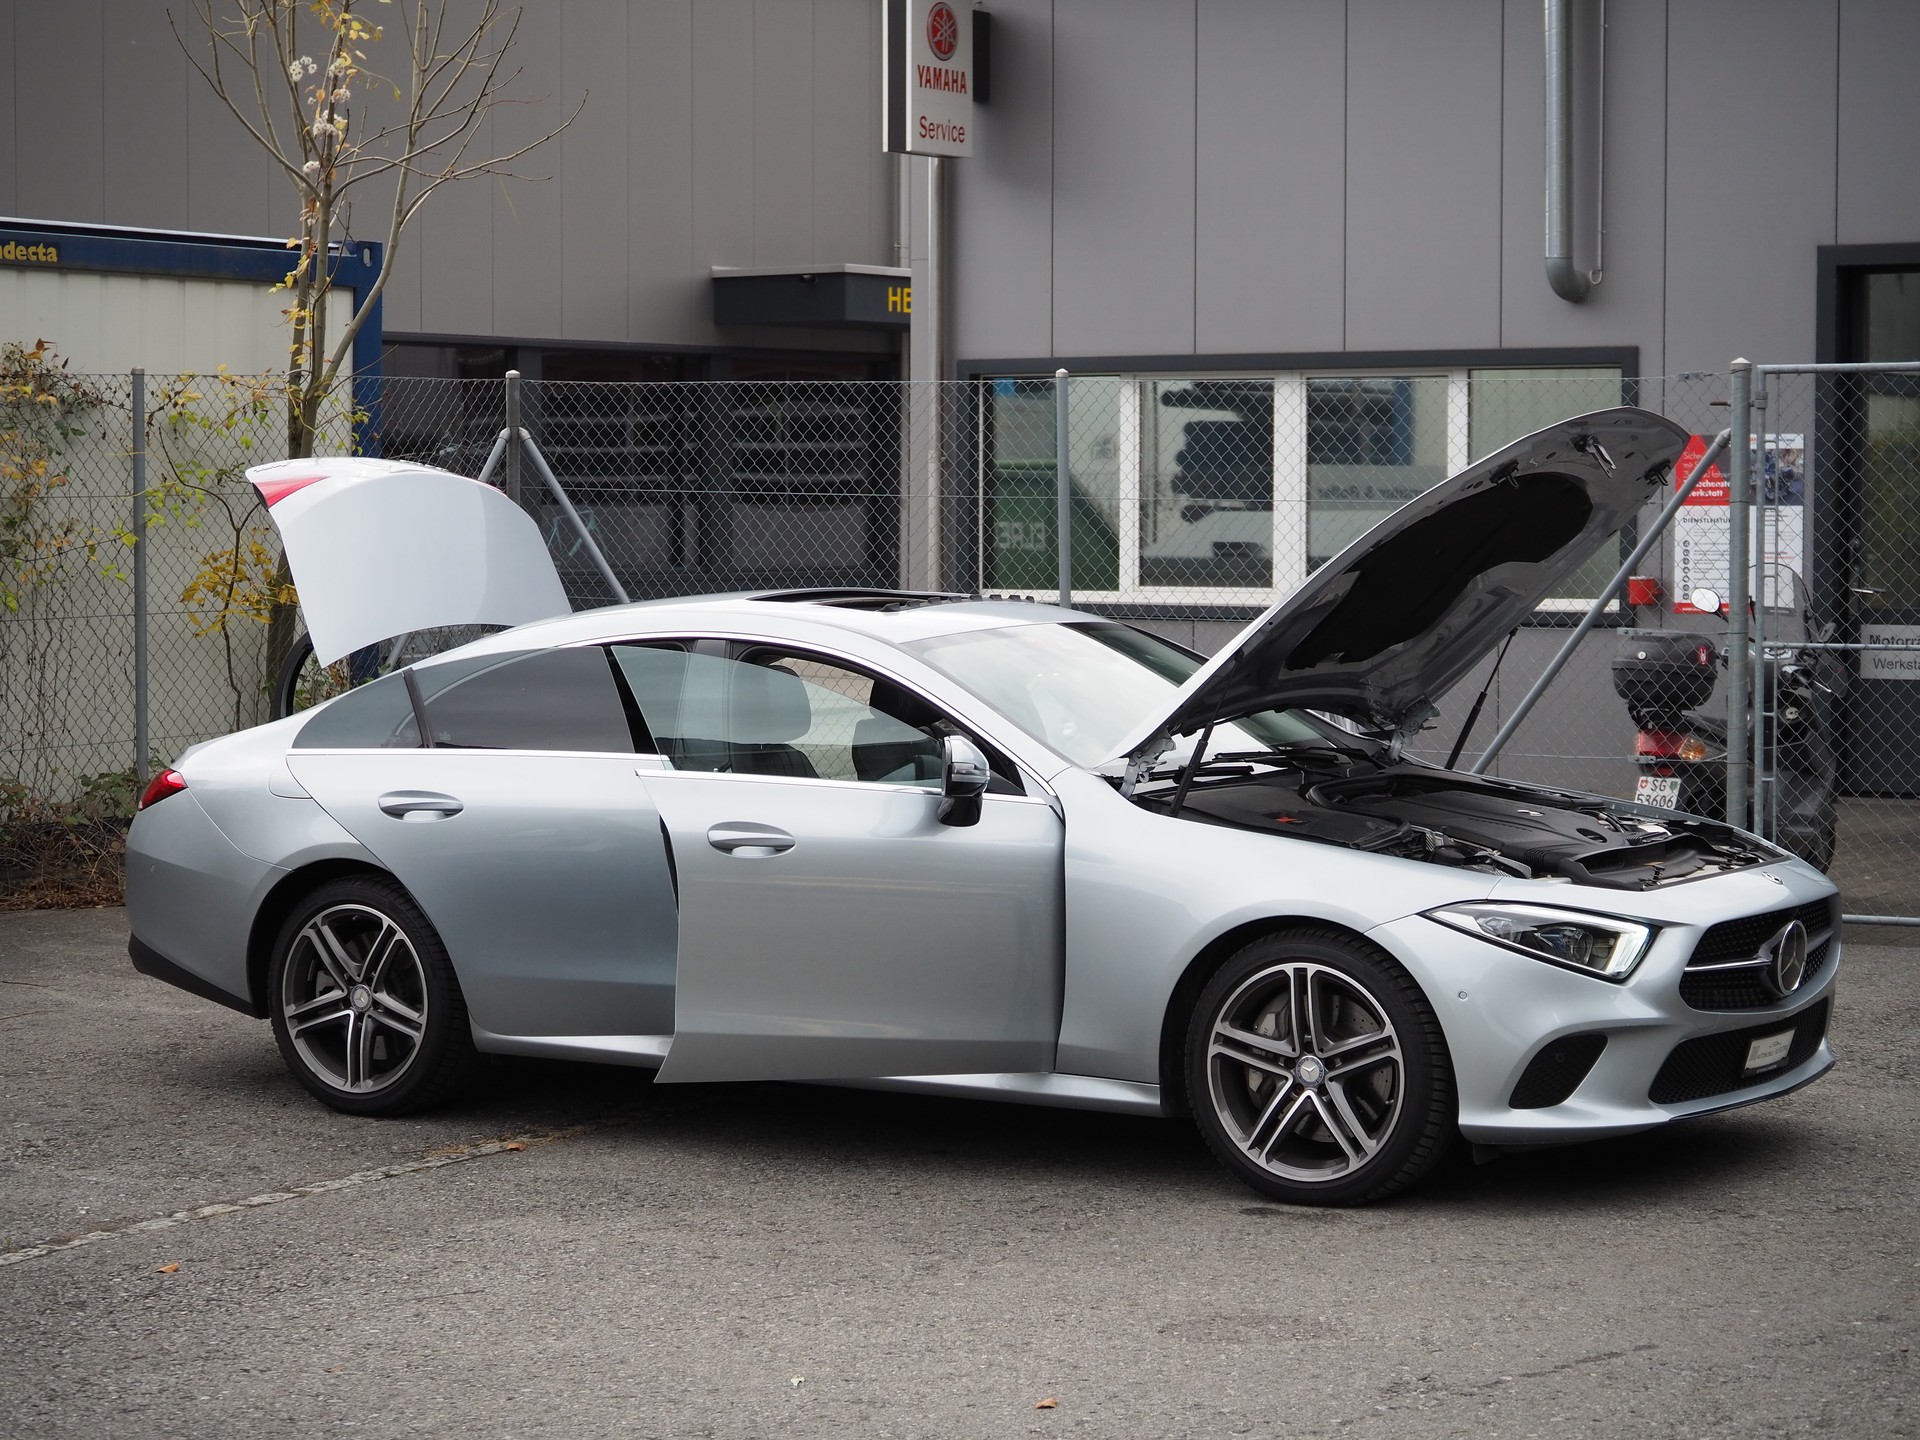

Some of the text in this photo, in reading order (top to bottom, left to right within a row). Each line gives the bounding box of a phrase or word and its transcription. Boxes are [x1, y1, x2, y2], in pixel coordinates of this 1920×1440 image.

[917, 65, 967, 94] YAMAHA
[919, 115, 965, 143] Service
[0, 241, 58, 262] decta
[1688, 489, 1724, 497] erkstatt
[1650, 778, 1667, 791] SG
